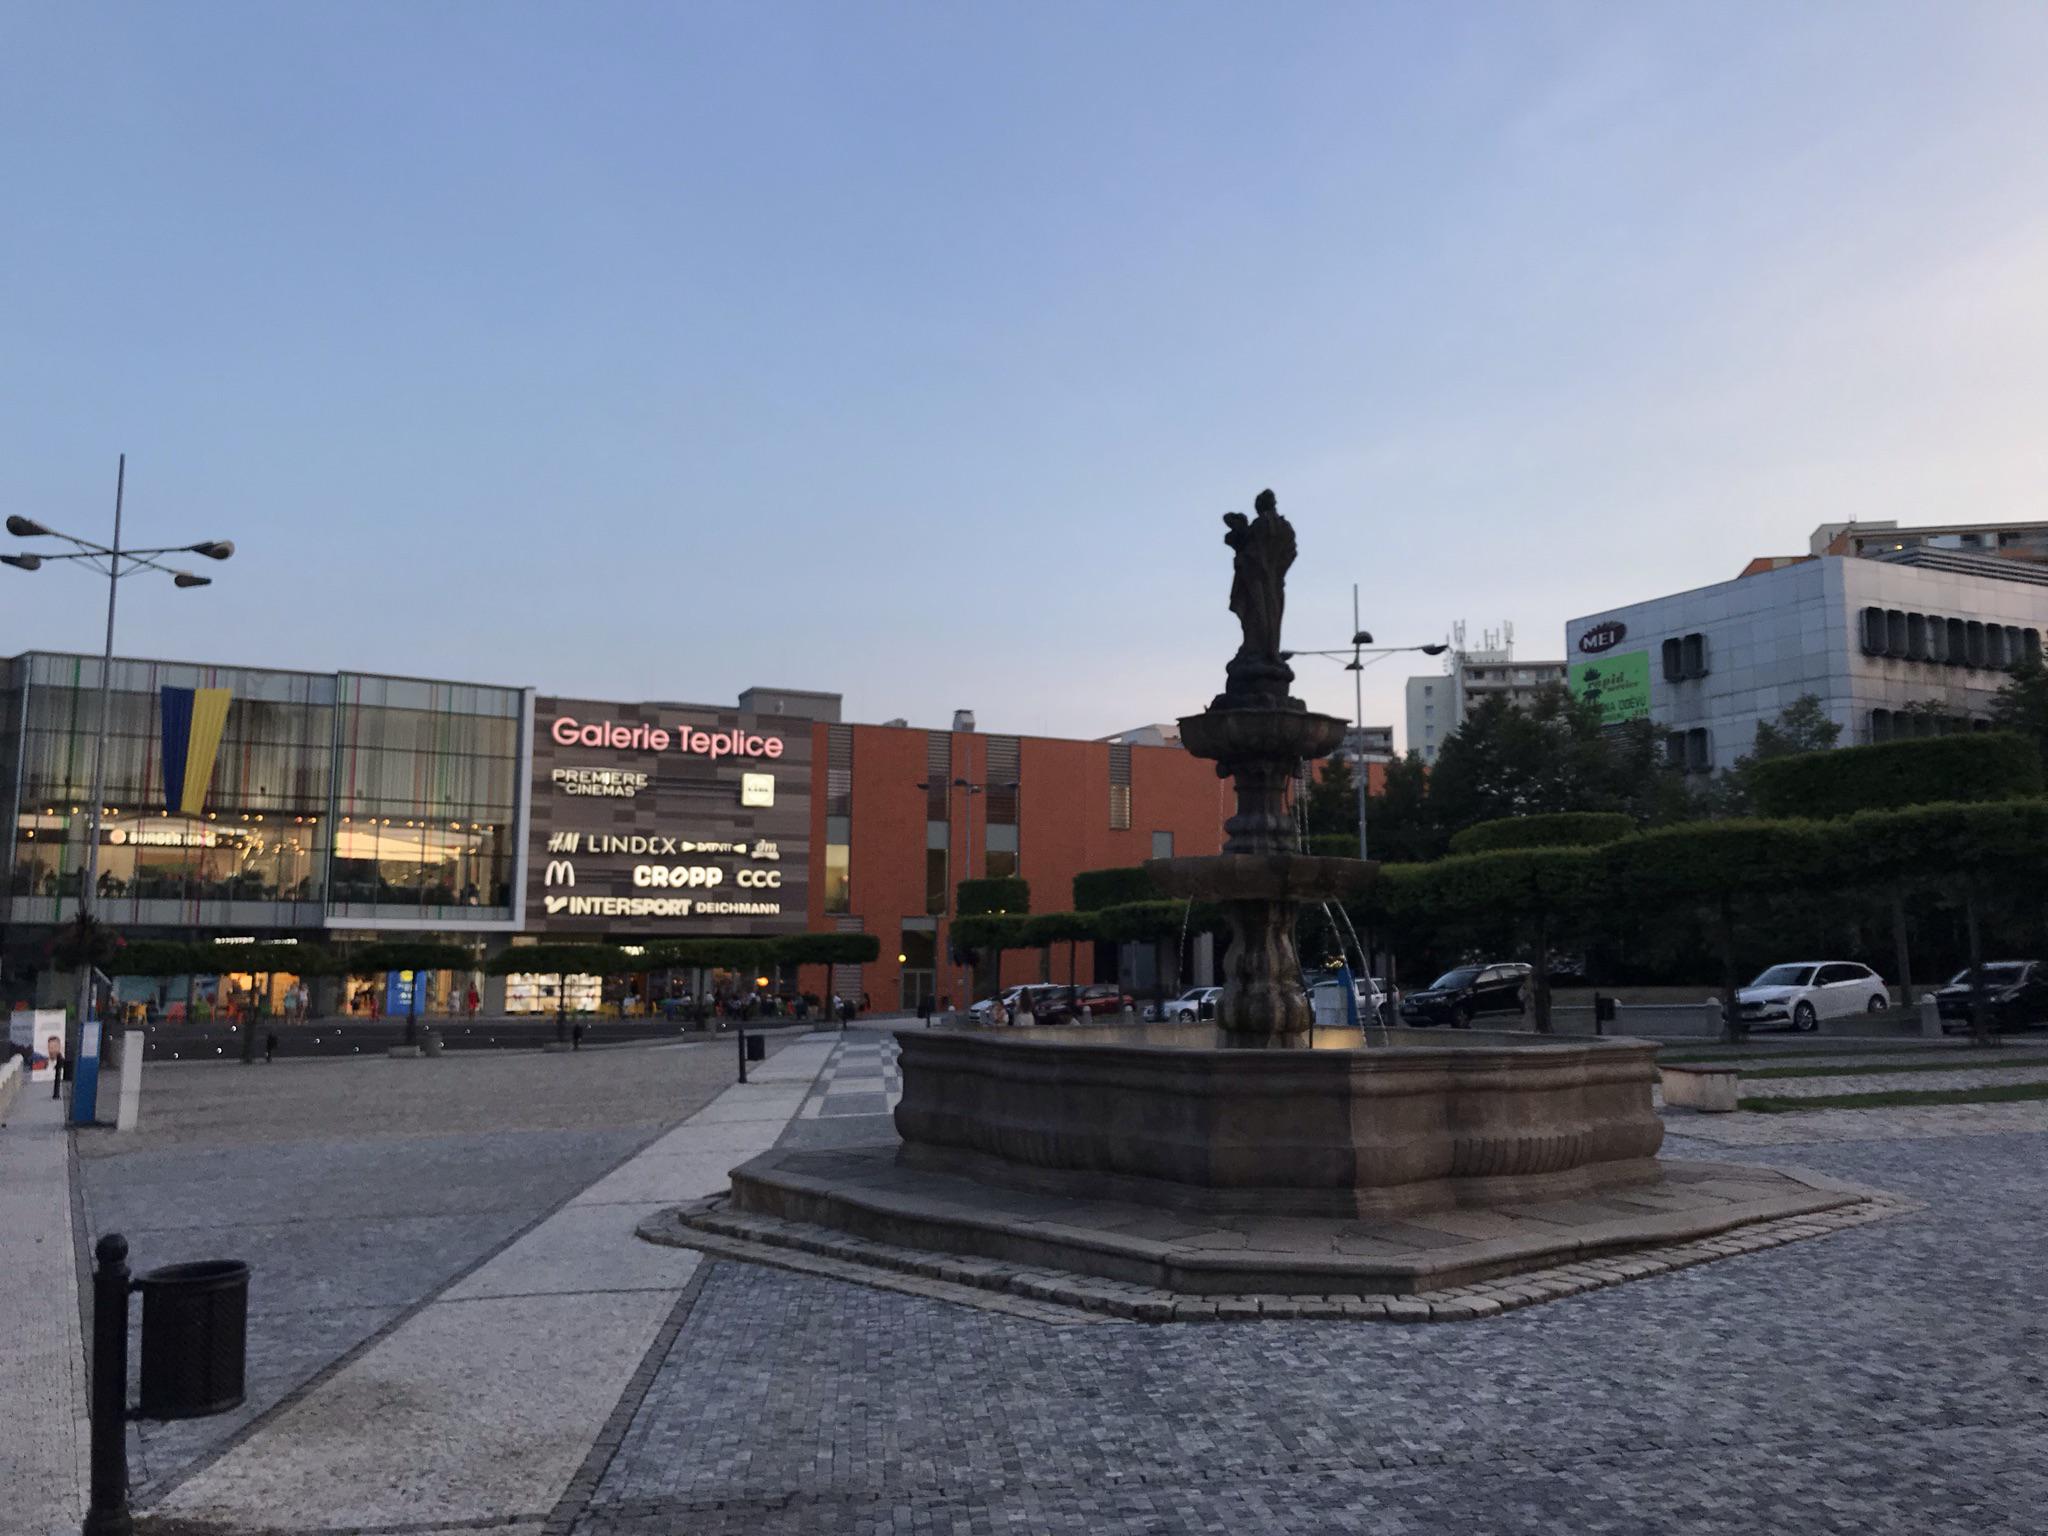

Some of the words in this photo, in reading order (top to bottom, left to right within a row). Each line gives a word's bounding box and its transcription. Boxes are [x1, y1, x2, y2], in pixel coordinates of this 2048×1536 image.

[1582, 630, 1615, 650] MEI
[552, 716, 670, 751] Galerie
[678, 725, 784, 760] Teplice
[552, 768, 648, 787] PREMIERE
[565, 782, 635, 797] CINEMAS
[587, 834, 677, 855] LINDEX
[633, 865, 723, 888] CROPP
[736, 869, 781, 888] CCC
[568, 896, 692, 917] INTERSPORT
[696, 901, 780, 915] DEICHMANN
